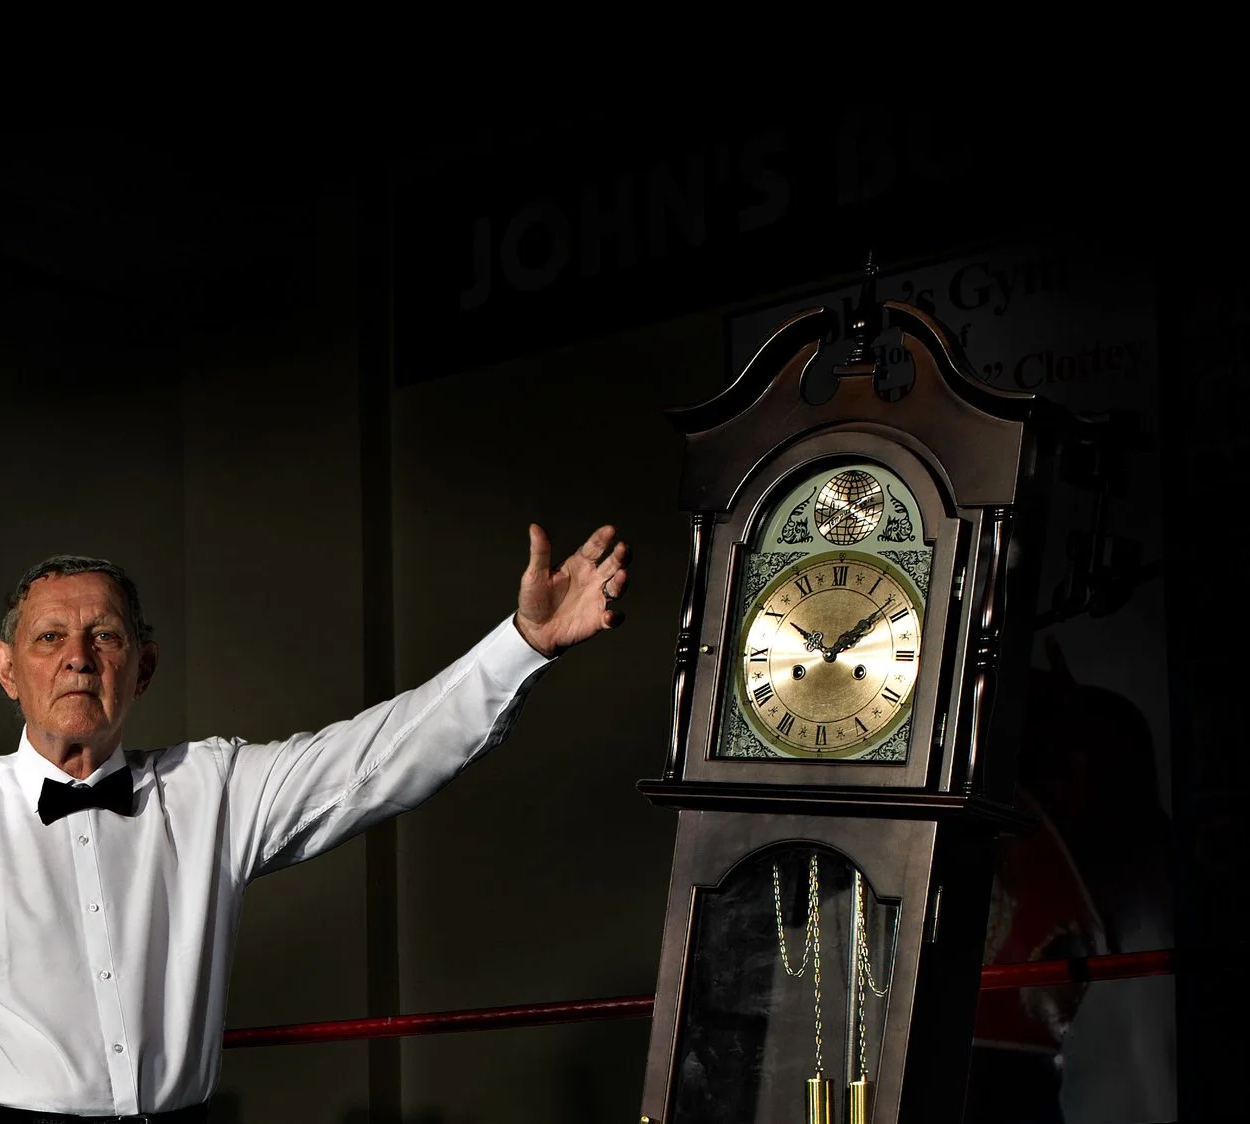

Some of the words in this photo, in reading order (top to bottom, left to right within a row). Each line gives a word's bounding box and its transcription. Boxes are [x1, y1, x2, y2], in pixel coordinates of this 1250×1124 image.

[458, 126, 792, 313] JOHN'S
[950, 256, 1066, 316] Gym
[794, 575, 814, 598] XI
[831, 566, 849, 586] XII
[868, 576, 883, 595] I
[765, 605, 785, 625] X
[889, 607, 910, 624] II
[750, 647, 769, 662] IX
[895, 650, 915, 662] III
[753, 682, 775, 708] VIII
[881, 686, 901, 708] IV
[776, 711, 795, 736] VII
[855, 716, 868, 737] V
[815, 725, 827, 746] VI
